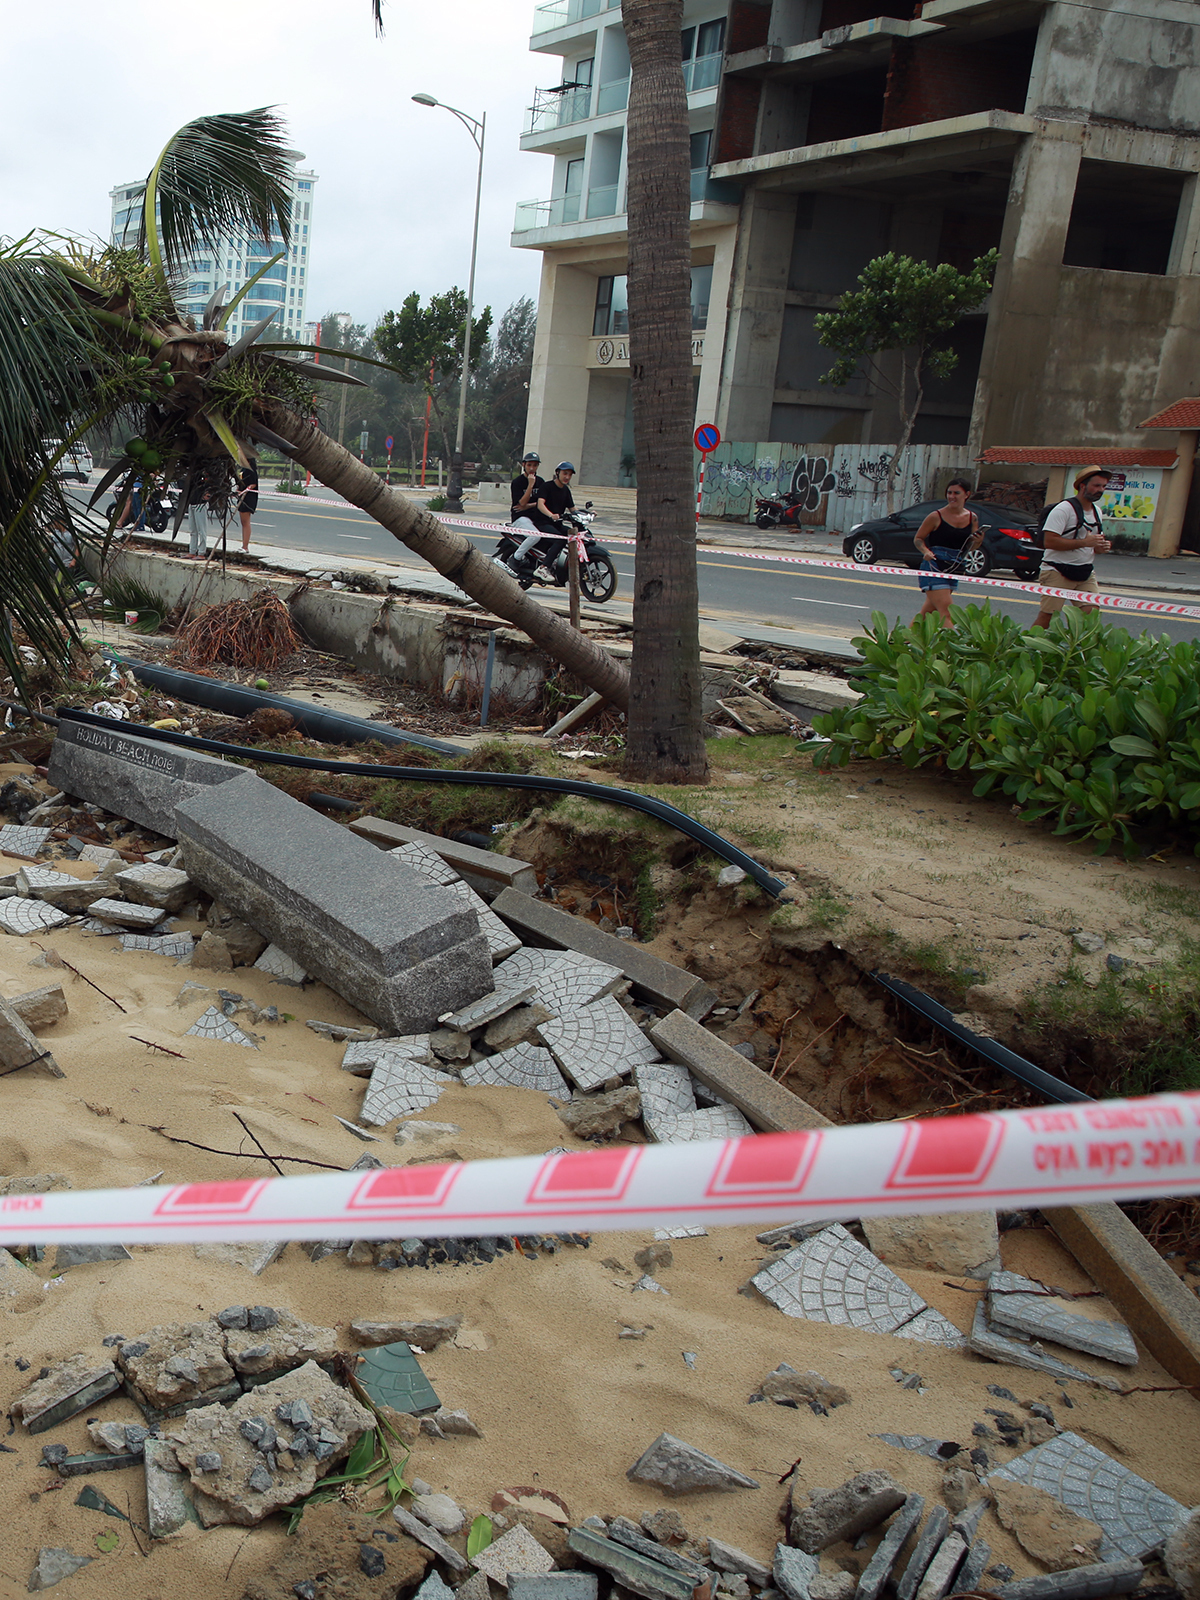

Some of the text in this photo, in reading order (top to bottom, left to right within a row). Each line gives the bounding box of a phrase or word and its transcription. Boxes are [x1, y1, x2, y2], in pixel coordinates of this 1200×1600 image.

[1125, 480, 1140, 490] Milk
[1141, 480, 1156, 490] Tea
[76, 727, 115, 750] HOLIDAY
[115, 740, 151, 762] BEACH
[1034, 1143, 1080, 1178] VÀO
[2, 1197, 44, 1212] KHU
